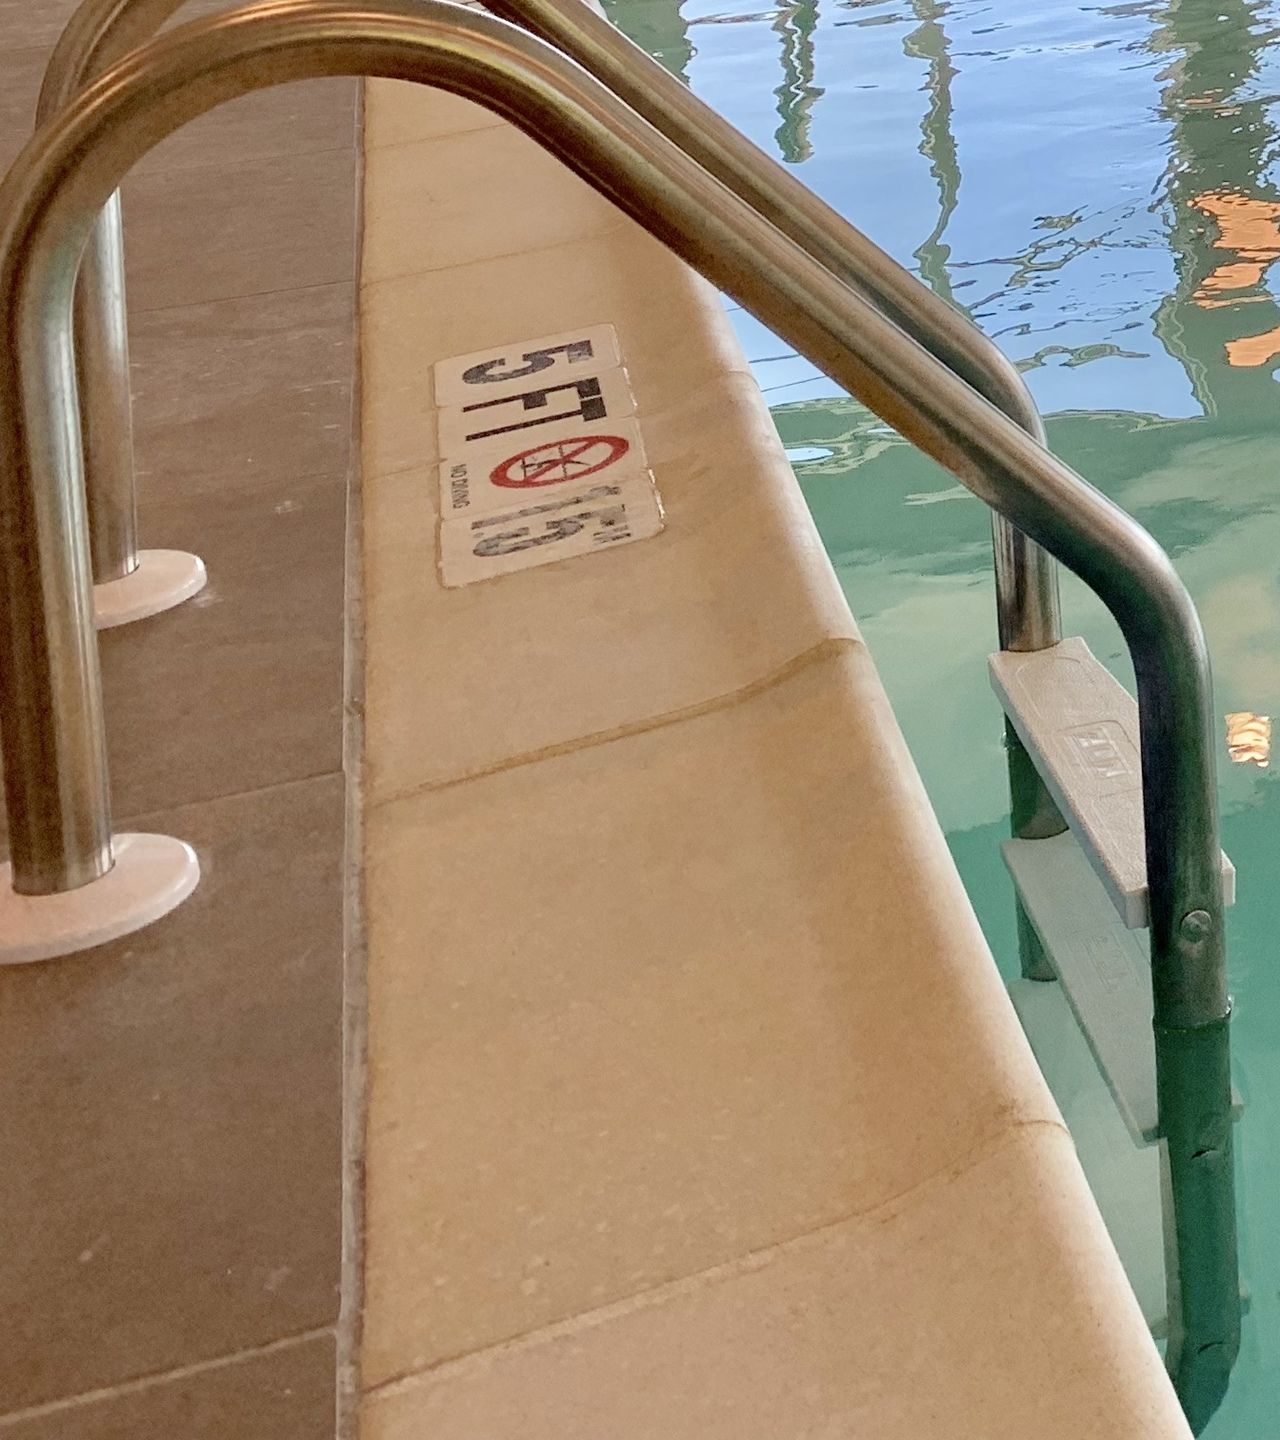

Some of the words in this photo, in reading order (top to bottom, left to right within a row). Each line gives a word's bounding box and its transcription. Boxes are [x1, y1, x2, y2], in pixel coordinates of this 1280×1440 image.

[462, 339, 594, 385] 5
[462, 377, 607, 442] FT
[451, 463, 468, 478] NO
[451, 478, 470, 509] DIVING
